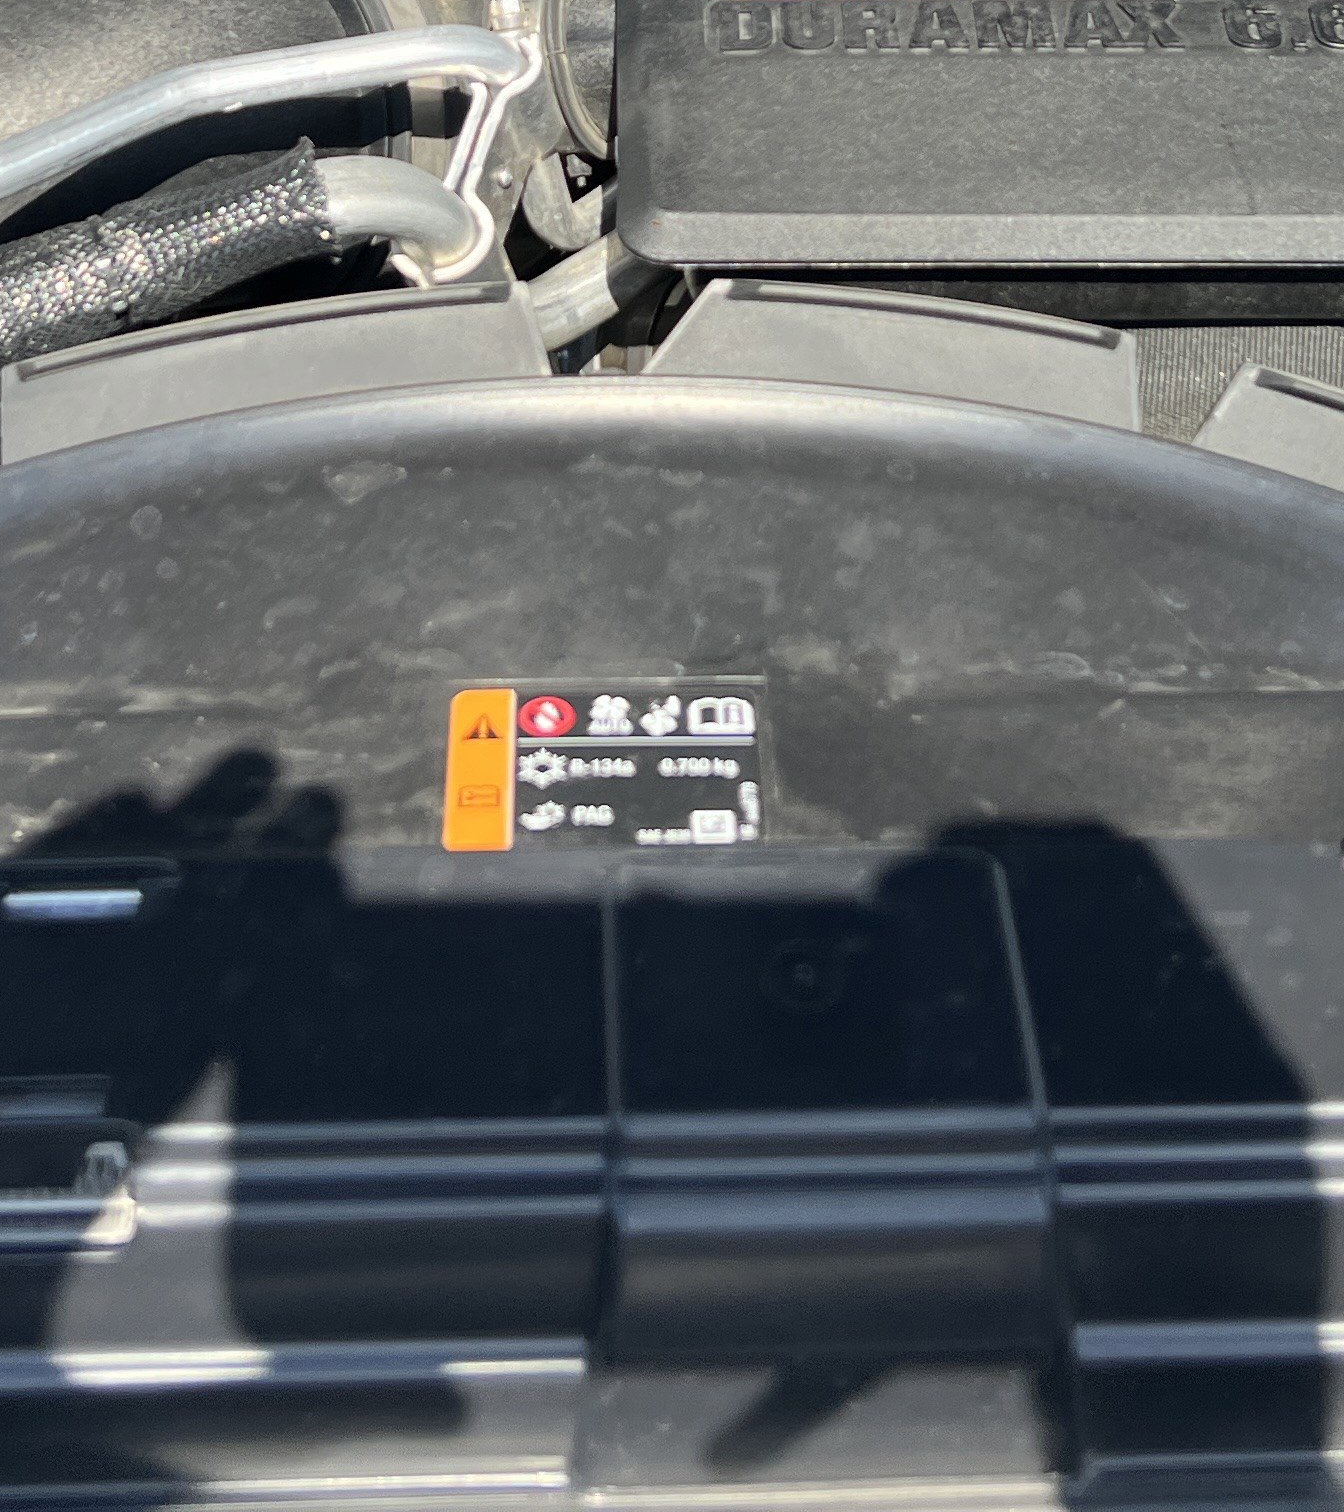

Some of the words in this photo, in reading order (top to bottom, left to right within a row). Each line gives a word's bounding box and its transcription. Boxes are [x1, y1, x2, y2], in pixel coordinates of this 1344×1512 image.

[569, 757, 637, 778] R-134a
[712, 757, 740, 780] kg
[570, 804, 615, 827] PAG
